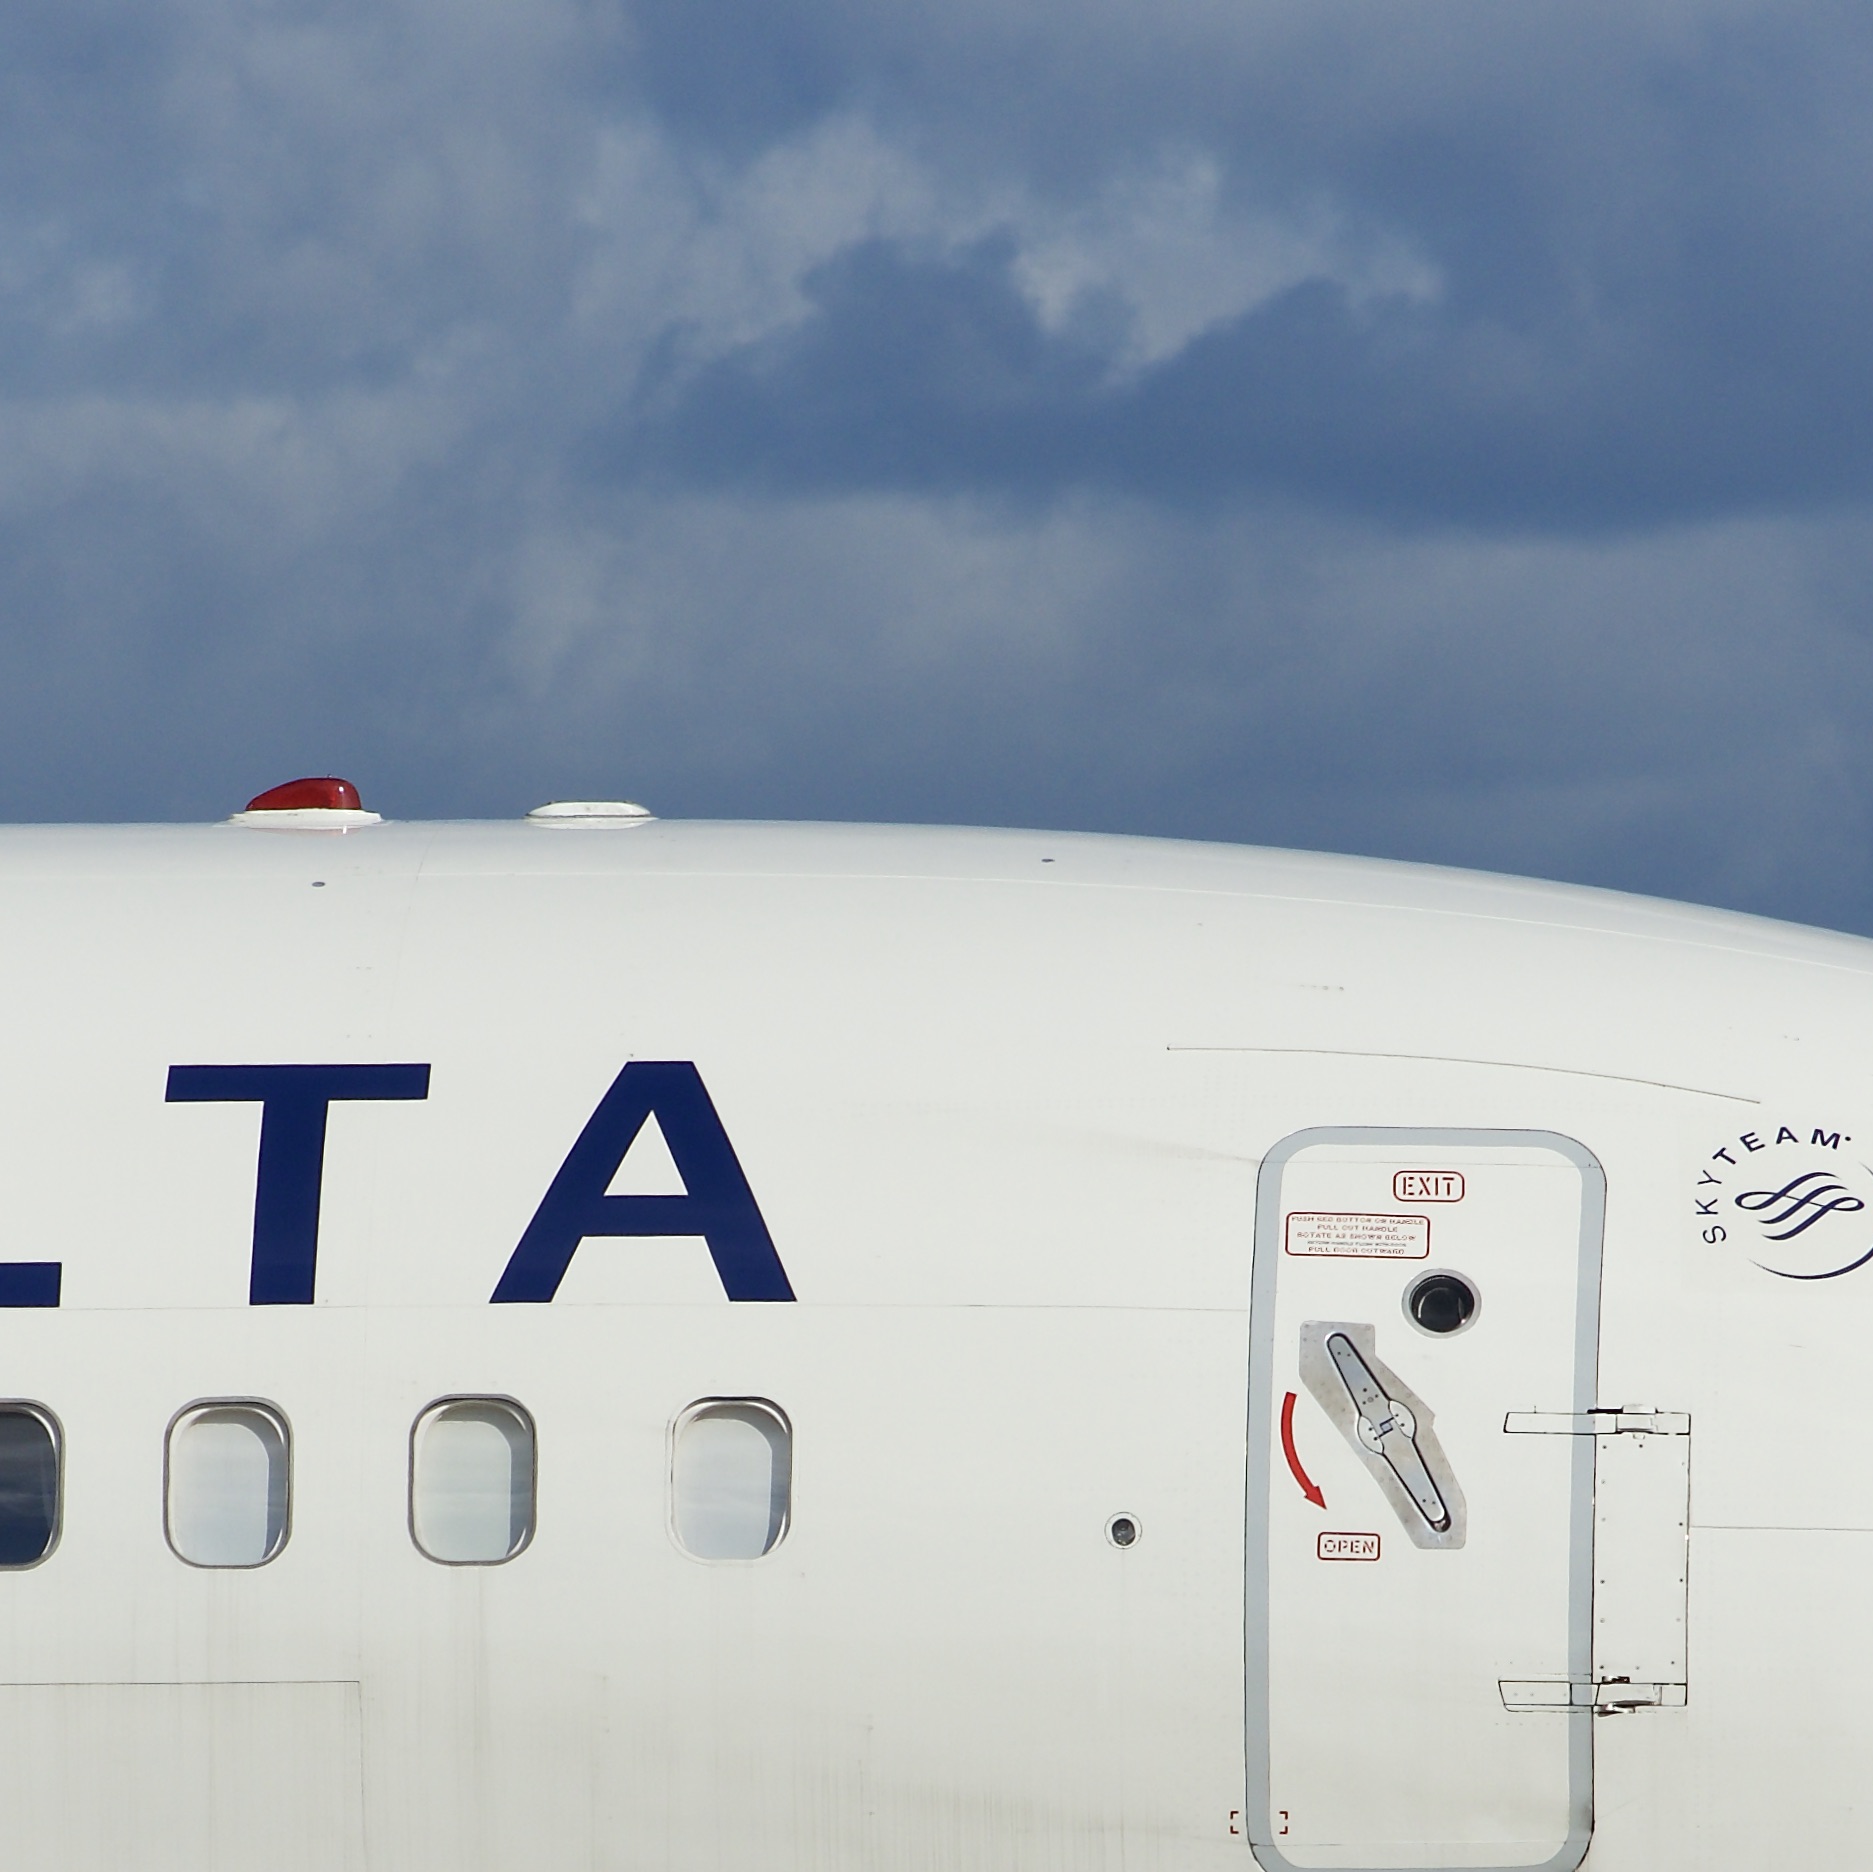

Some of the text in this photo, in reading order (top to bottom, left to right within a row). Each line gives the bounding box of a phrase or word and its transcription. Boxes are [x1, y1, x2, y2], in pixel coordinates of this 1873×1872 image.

[1403, 1176, 1455, 1196] EXIT
[1695, 1126, 1841, 1244] SKYTEAM
[1324, 1540, 1374, 1553] OPEN
